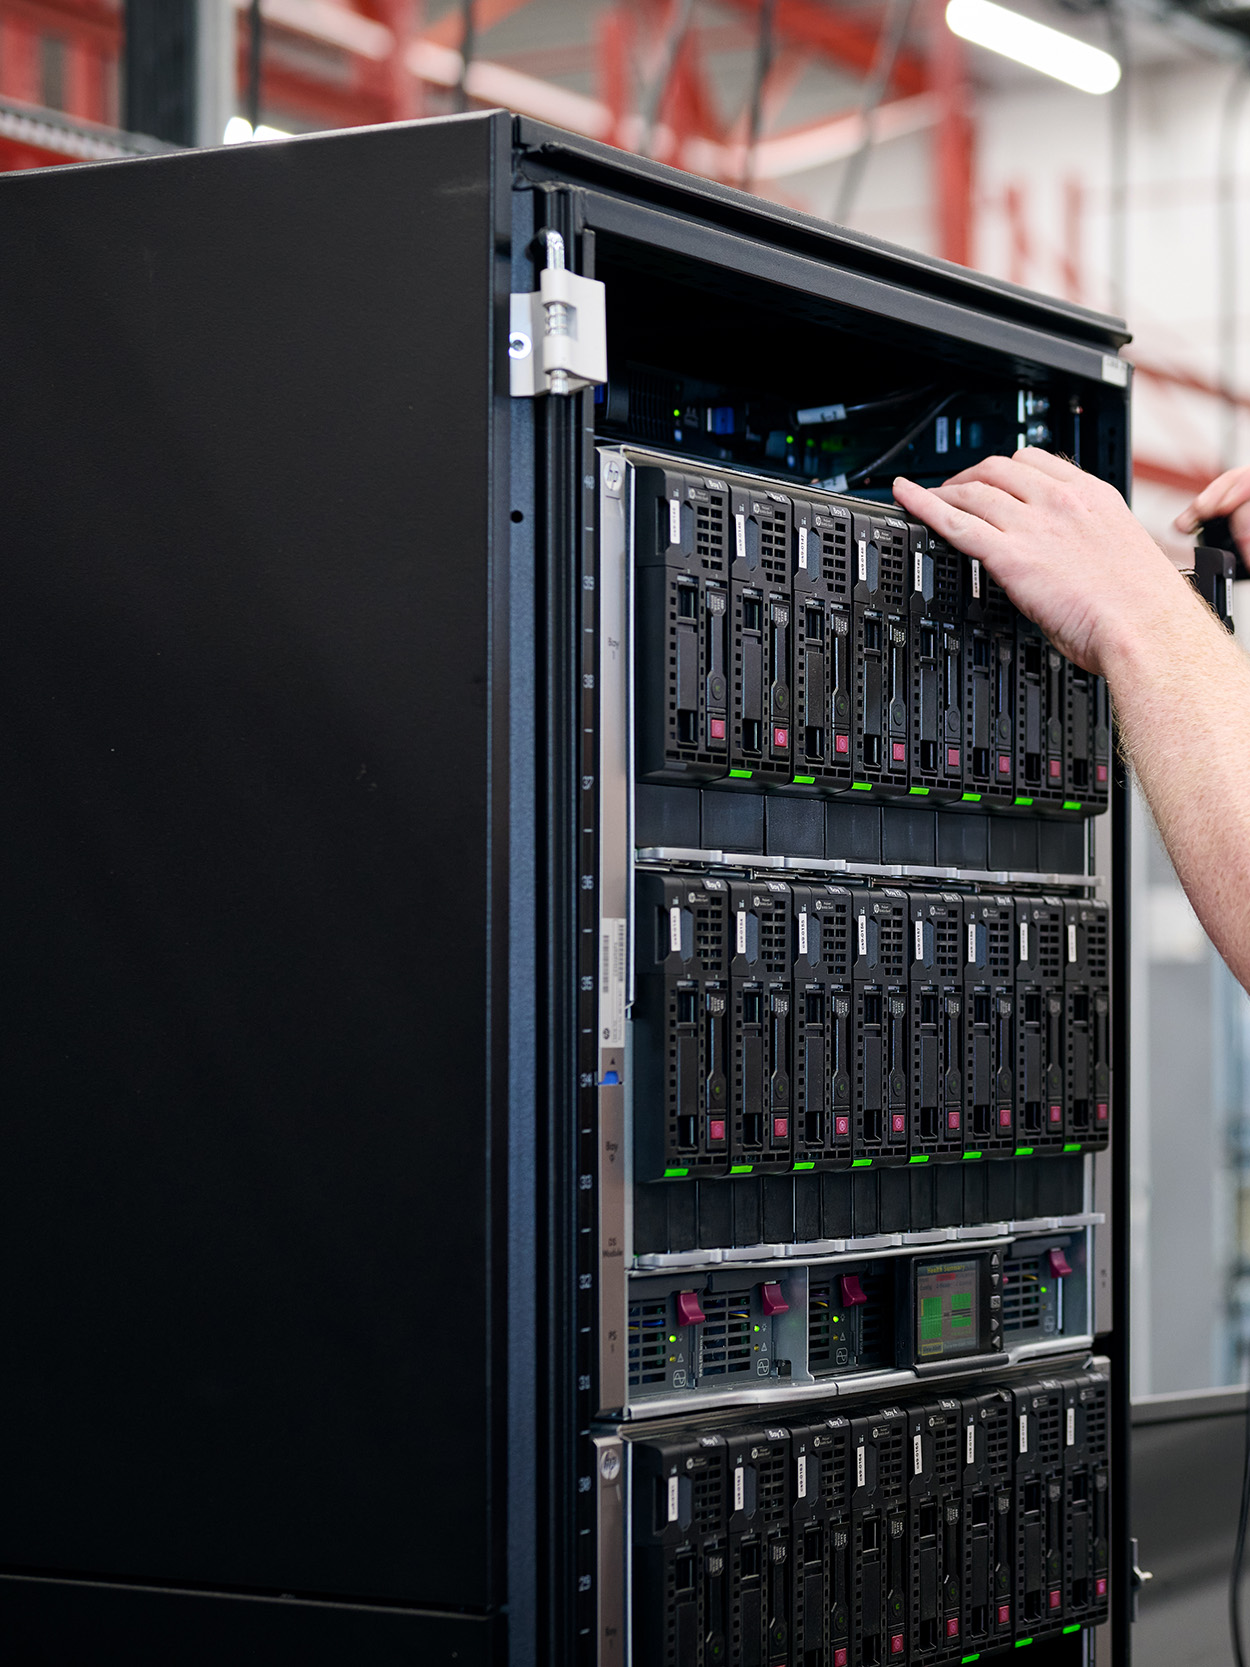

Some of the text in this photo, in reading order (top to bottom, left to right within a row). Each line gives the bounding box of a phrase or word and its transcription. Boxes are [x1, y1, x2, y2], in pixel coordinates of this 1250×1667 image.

[583, 474, 595, 490] 40
[605, 461, 620, 490] hp
[708, 480, 719, 489] Bay
[832, 507, 842, 516] Bay
[583, 575, 595, 591] 39
[608, 637, 619, 650] Bay
[582, 775, 594, 790] 37
[581, 875, 594, 890] 36
[705, 880, 717, 890] Bay
[769, 882, 780, 891] Bay
[581, 975, 593, 991] 35
[580, 1072, 593, 1088] 34
[605, 1141, 619, 1153] Bay
[579, 1174, 593, 1190] 33
[579, 1273, 592, 1289] 32
[608, 1330, 617, 1341] PS
[578, 1375, 591, 1391] 31
[828, 1419, 840, 1427] Bay
[768, 1430, 780, 1439] Bay
[578, 1475, 592, 1493] 30
[578, 1574, 592, 1592] 29
